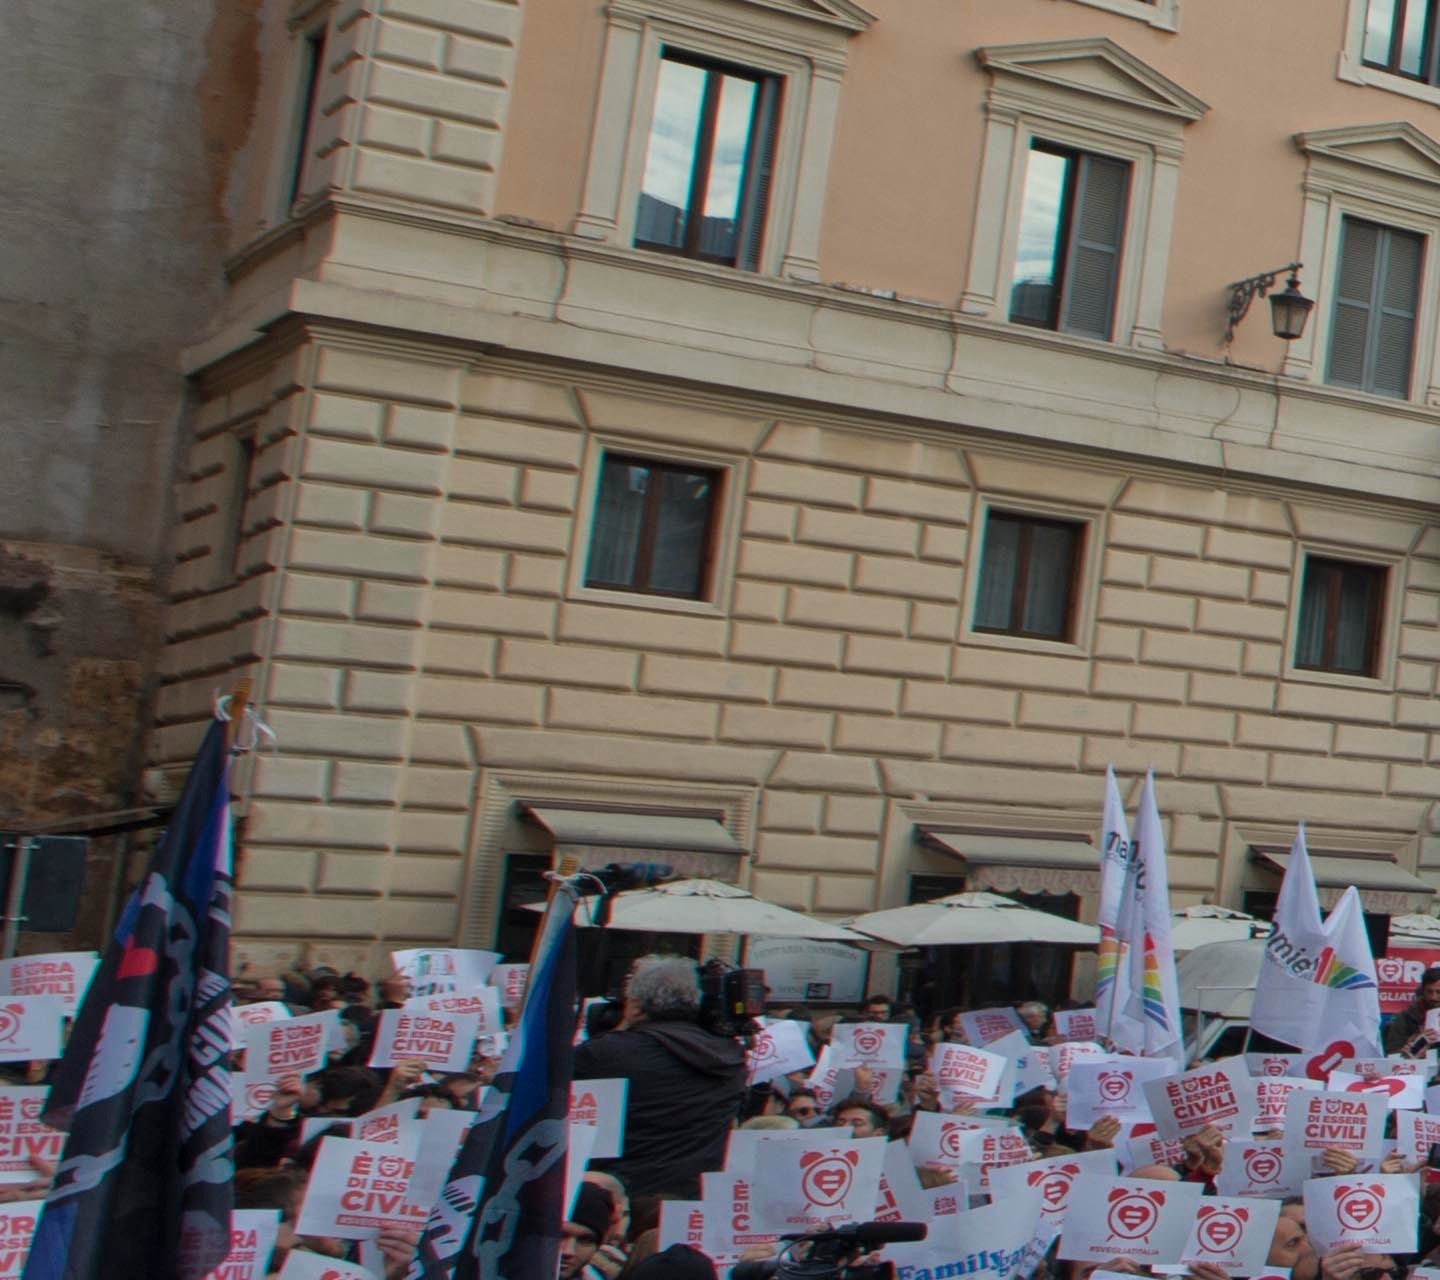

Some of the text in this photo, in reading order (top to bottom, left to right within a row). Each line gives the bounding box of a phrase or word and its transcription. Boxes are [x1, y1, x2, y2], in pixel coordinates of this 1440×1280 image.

[1166, 1072, 1230, 1098] È ORA
[1171, 1083, 1232, 1107] DI ESSERE
[1174, 1091, 1236, 1120] CIVILI
[1308, 1095, 1367, 1116] È ORA
[1308, 1115, 1367, 1125] DI ESSERE
[1305, 1125, 1367, 1140] CIVILI
